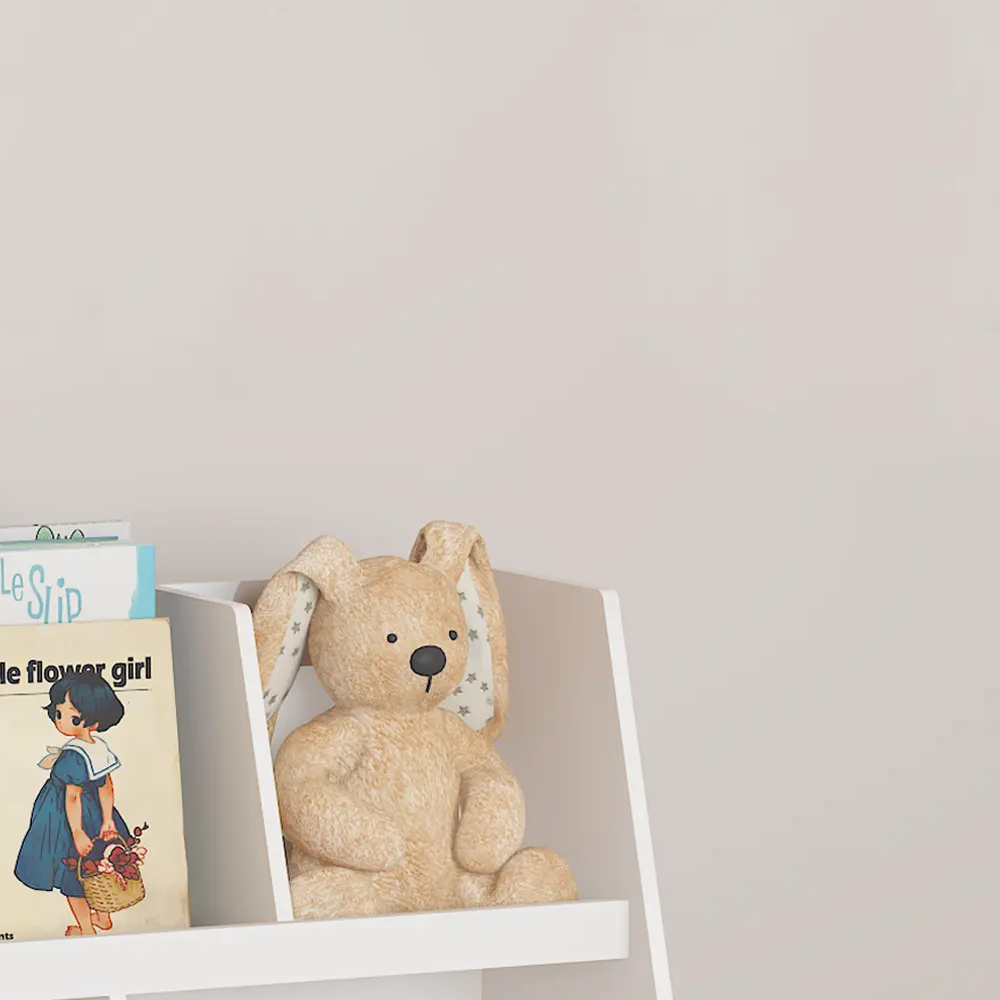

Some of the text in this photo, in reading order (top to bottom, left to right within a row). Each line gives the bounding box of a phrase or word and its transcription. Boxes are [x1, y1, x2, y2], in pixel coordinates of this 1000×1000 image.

[0, 557, 82, 624] Le Slip
[111, 656, 152, 687] girl
